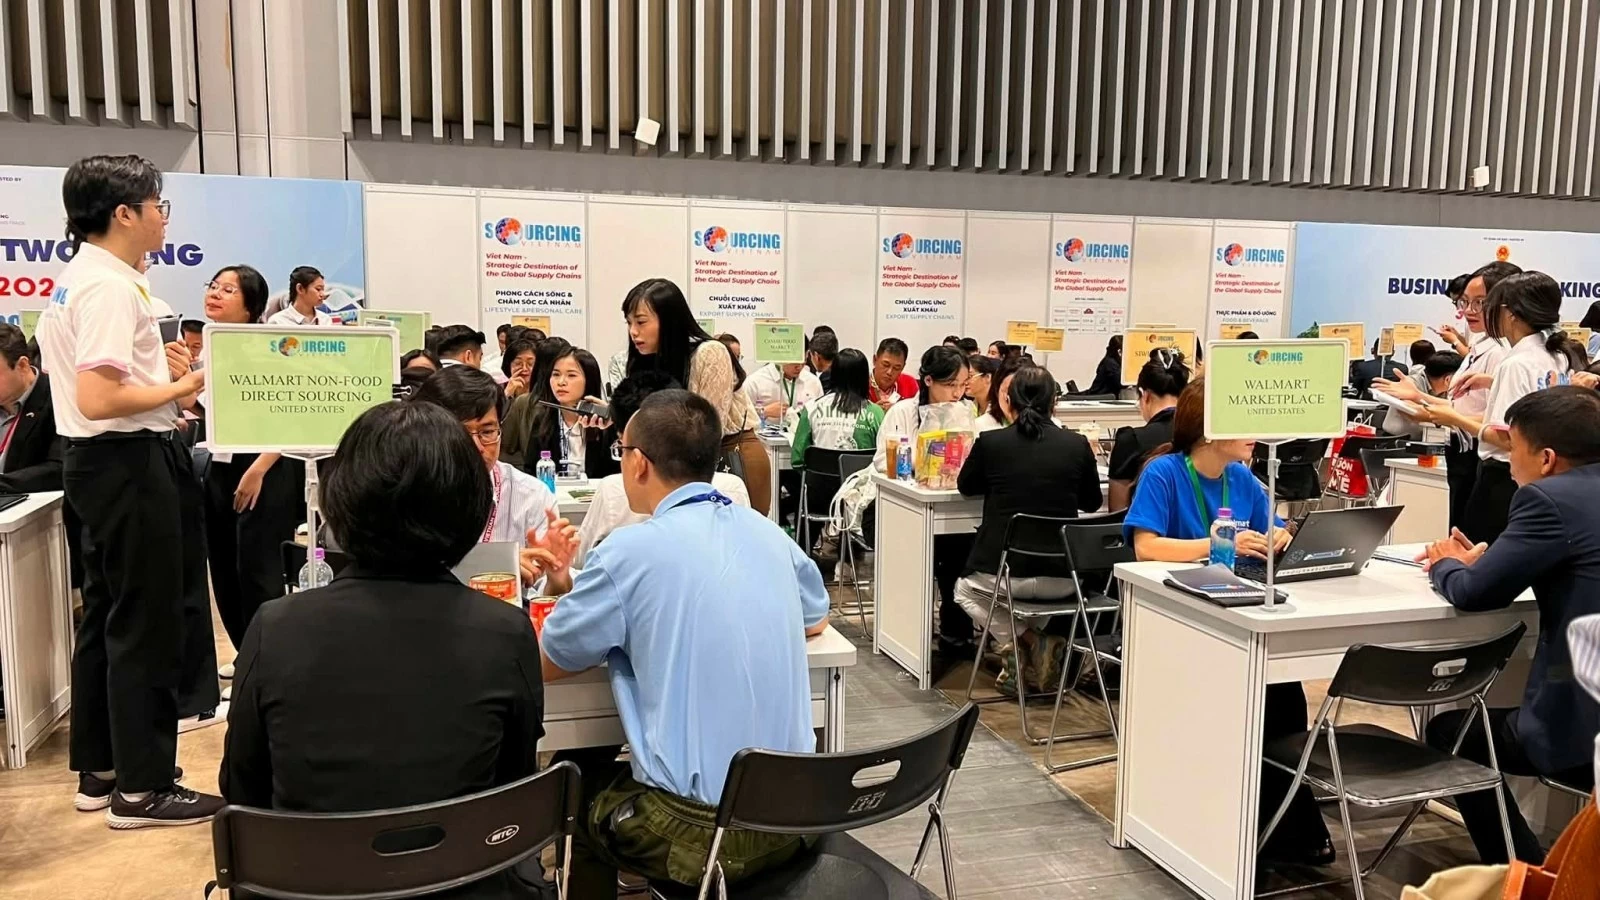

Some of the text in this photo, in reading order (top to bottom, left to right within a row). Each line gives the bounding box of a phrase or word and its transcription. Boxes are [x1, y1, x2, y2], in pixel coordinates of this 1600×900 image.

[0, 238, 204, 266] TWONG
[486, 262, 521, 270] Strategic
[0, 277, 54, 297] 202
[1388, 278, 1450, 294] BUSIN
[228, 374, 382, 387] WALMART NON-FOOD
[1245, 379, 1310, 390] WALMART
[241, 390, 372, 402] DIRECT SOURCING
[1228, 394, 1325, 405] MARKETPLACE
[269, 405, 308, 414] UNITED
[492, 828, 516, 842] MTC
